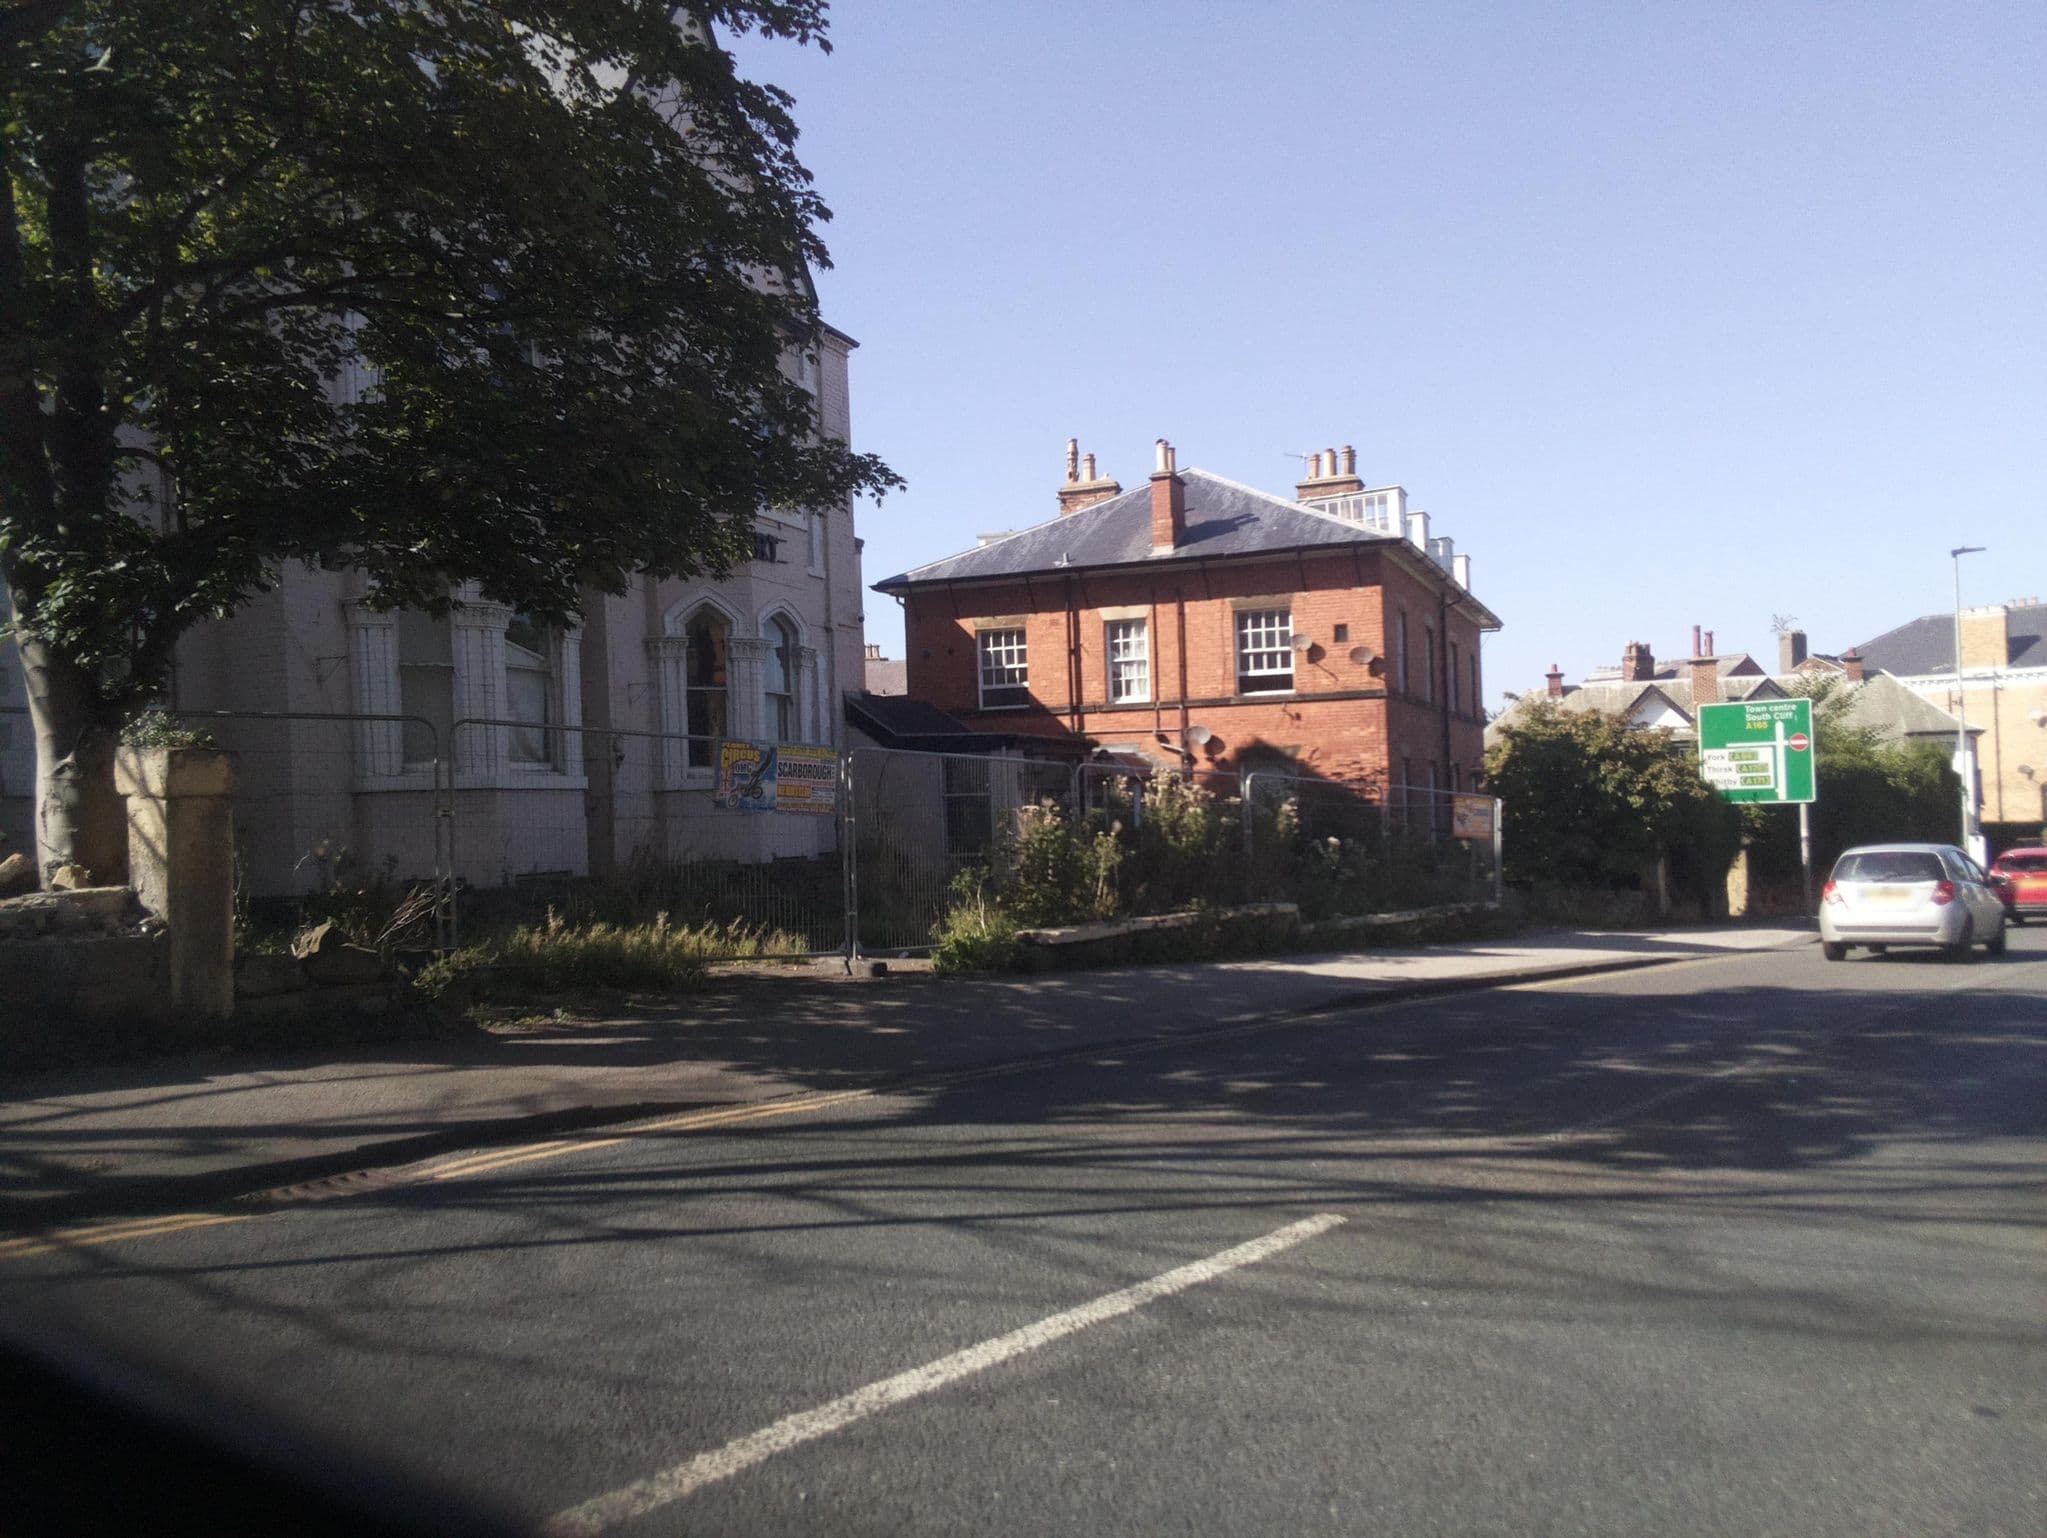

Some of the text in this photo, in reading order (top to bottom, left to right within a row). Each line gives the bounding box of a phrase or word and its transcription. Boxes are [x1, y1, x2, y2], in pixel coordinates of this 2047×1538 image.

[1744, 703, 1797, 713] Town centre
[1745, 711, 1794, 721] South Cliff
[721, 748, 761, 768] CIRCUS
[777, 761, 832, 781] SCARBOROUGH
